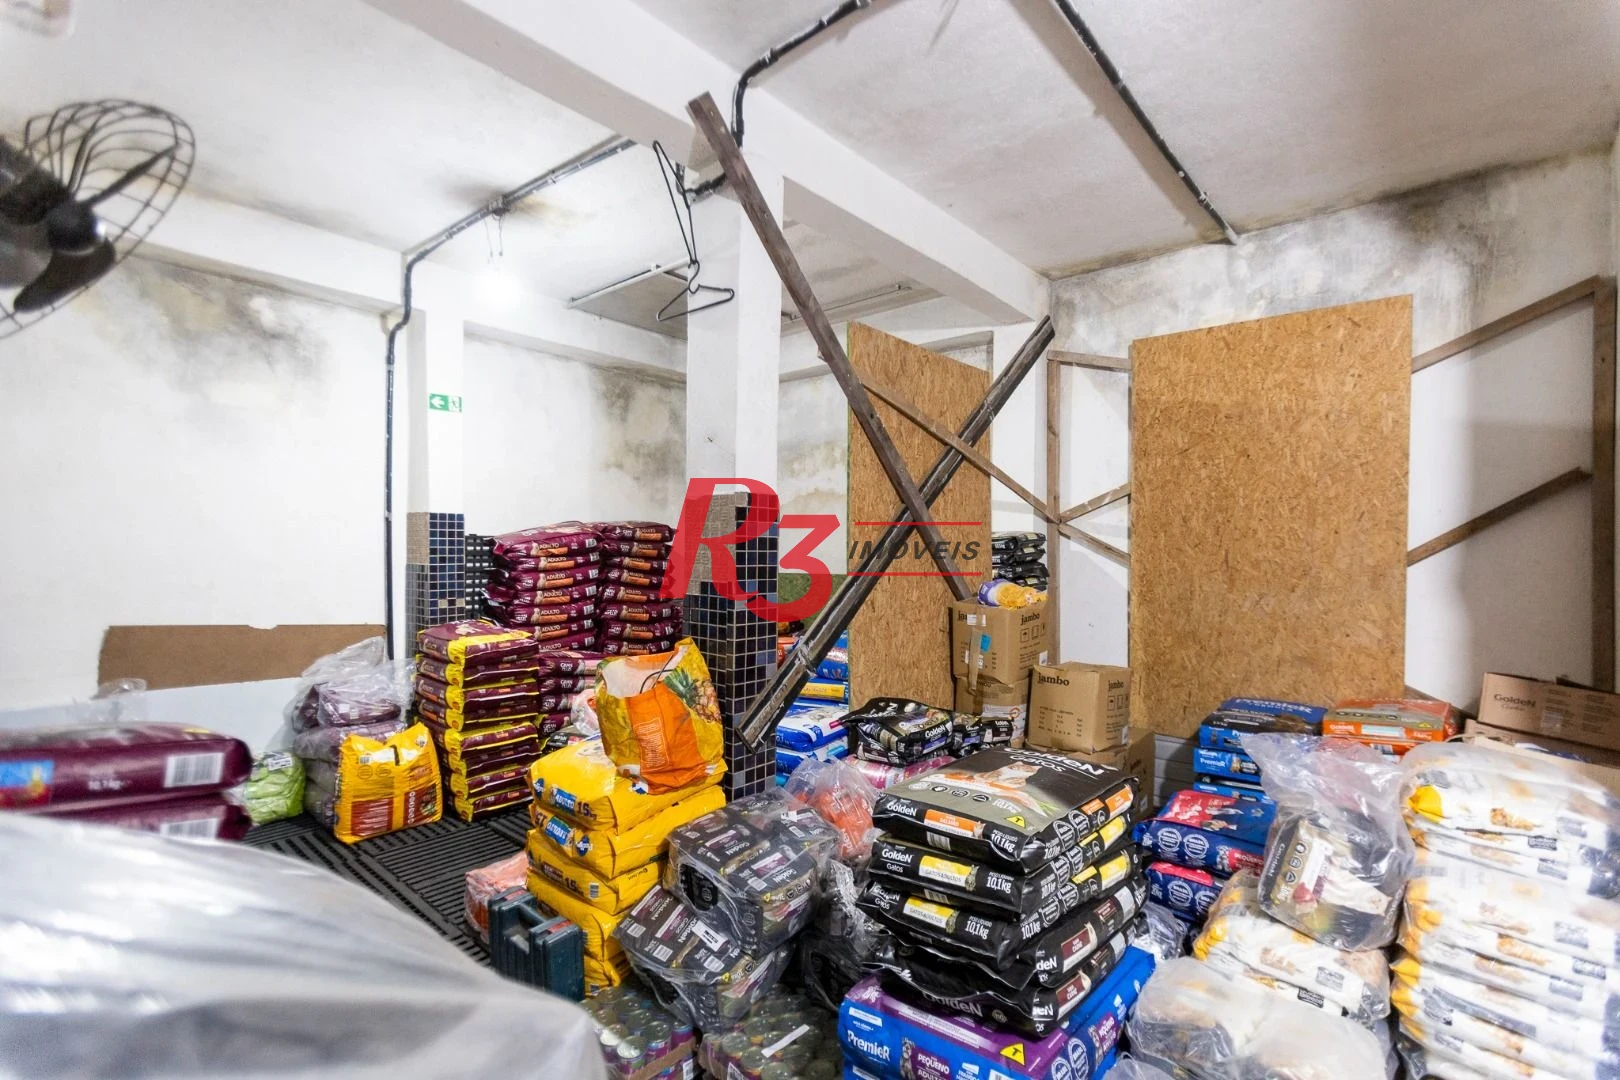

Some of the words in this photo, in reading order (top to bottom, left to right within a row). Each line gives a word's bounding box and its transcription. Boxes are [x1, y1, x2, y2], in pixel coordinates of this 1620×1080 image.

[1021, 612, 1040, 625] jambo
[1038, 673, 1070, 686] jambo
[1108, 680, 1124, 691] jambo
[881, 848, 914, 864] GoldeN
[986, 876, 1012, 894] 10,1kg
[965, 920, 990, 940] 10,1kg
[847, 1029, 891, 1062] PremieR
[917, 1053, 950, 1075] PEQUENO
